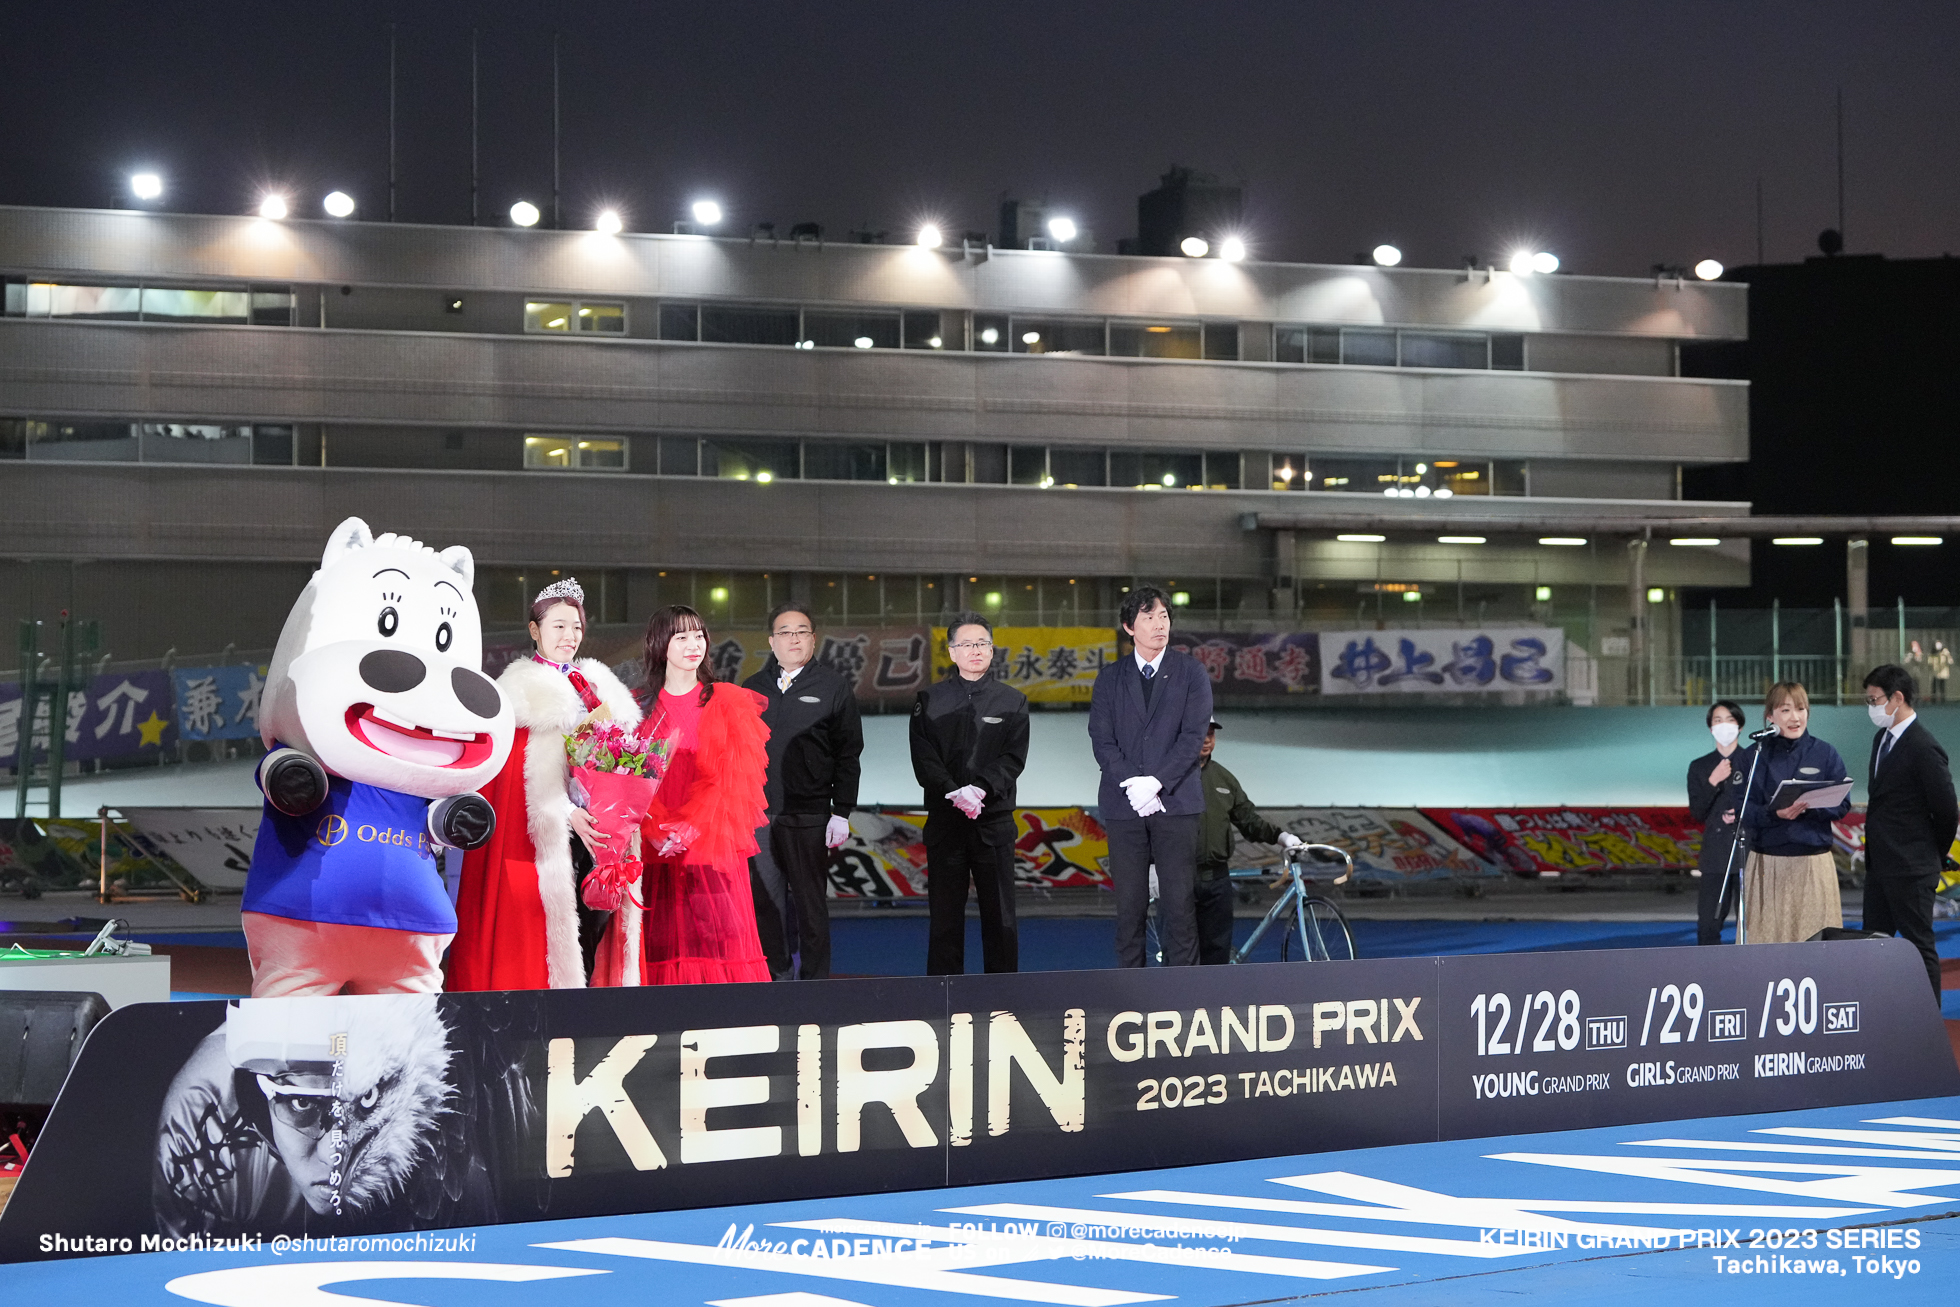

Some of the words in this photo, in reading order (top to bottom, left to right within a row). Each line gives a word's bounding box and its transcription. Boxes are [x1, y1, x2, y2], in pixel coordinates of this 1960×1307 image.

[357, 824, 413, 848] Odds
[1107, 1004, 1295, 1062] GRAND
[1313, 997, 1424, 1049] PRIX
[1470, 990, 1581, 1056] 12/28
[1588, 1021, 1624, 1046] THU
[1640, 982, 1704, 1046] /29
[1715, 1014, 1741, 1037] FRI
[1758, 976, 1818, 1039] /30
[1827, 1006, 1855, 1030] SAT
[546, 1009, 1086, 1178] KEIRIN
[1137, 1074, 1228, 1111] 2023
[1239, 1062, 1397, 1099] TACHIKAWA
[1472, 1070, 1539, 1100] YOUNG
[1543, 1075, 1584, 1095] GRAND
[1586, 1073, 1610, 1091] PRIX
[1626, 1060, 1676, 1088] GIRLS
[1677, 1065, 1715, 1084] GRAND
[1717, 1063, 1740, 1081] PRIX
[1754, 1051, 1806, 1078] KEIRIN
[1807, 1056, 1843, 1074] GRAND
[1844, 1053, 1866, 1071] PRIX
[328, 1032, 350, 1216] 頂だけを、見つめろ。
